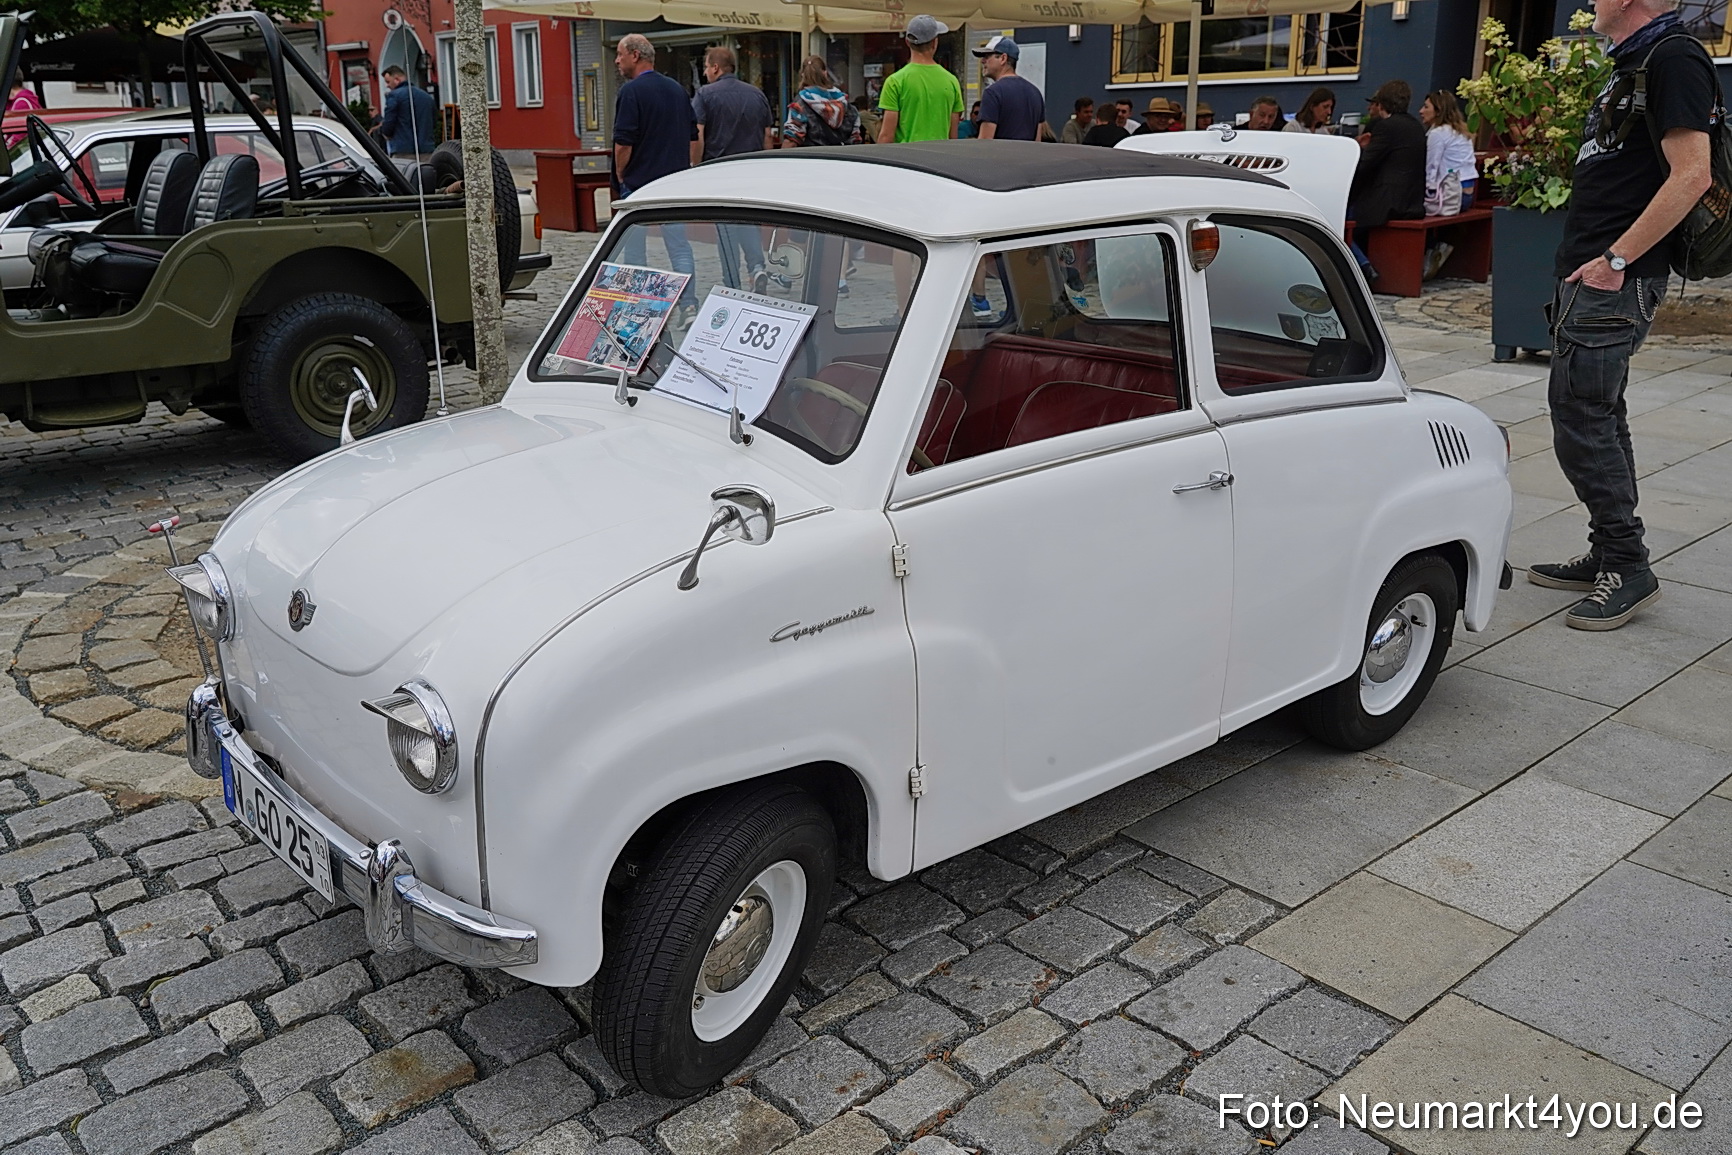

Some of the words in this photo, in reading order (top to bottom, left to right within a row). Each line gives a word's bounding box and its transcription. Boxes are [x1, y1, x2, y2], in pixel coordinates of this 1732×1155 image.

[739, 320, 781, 350] 583
[254, 786, 282, 850] GO
[286, 814, 314, 878] 25
[314, 840, 326, 860] 03
[319, 874, 330, 893] 10
